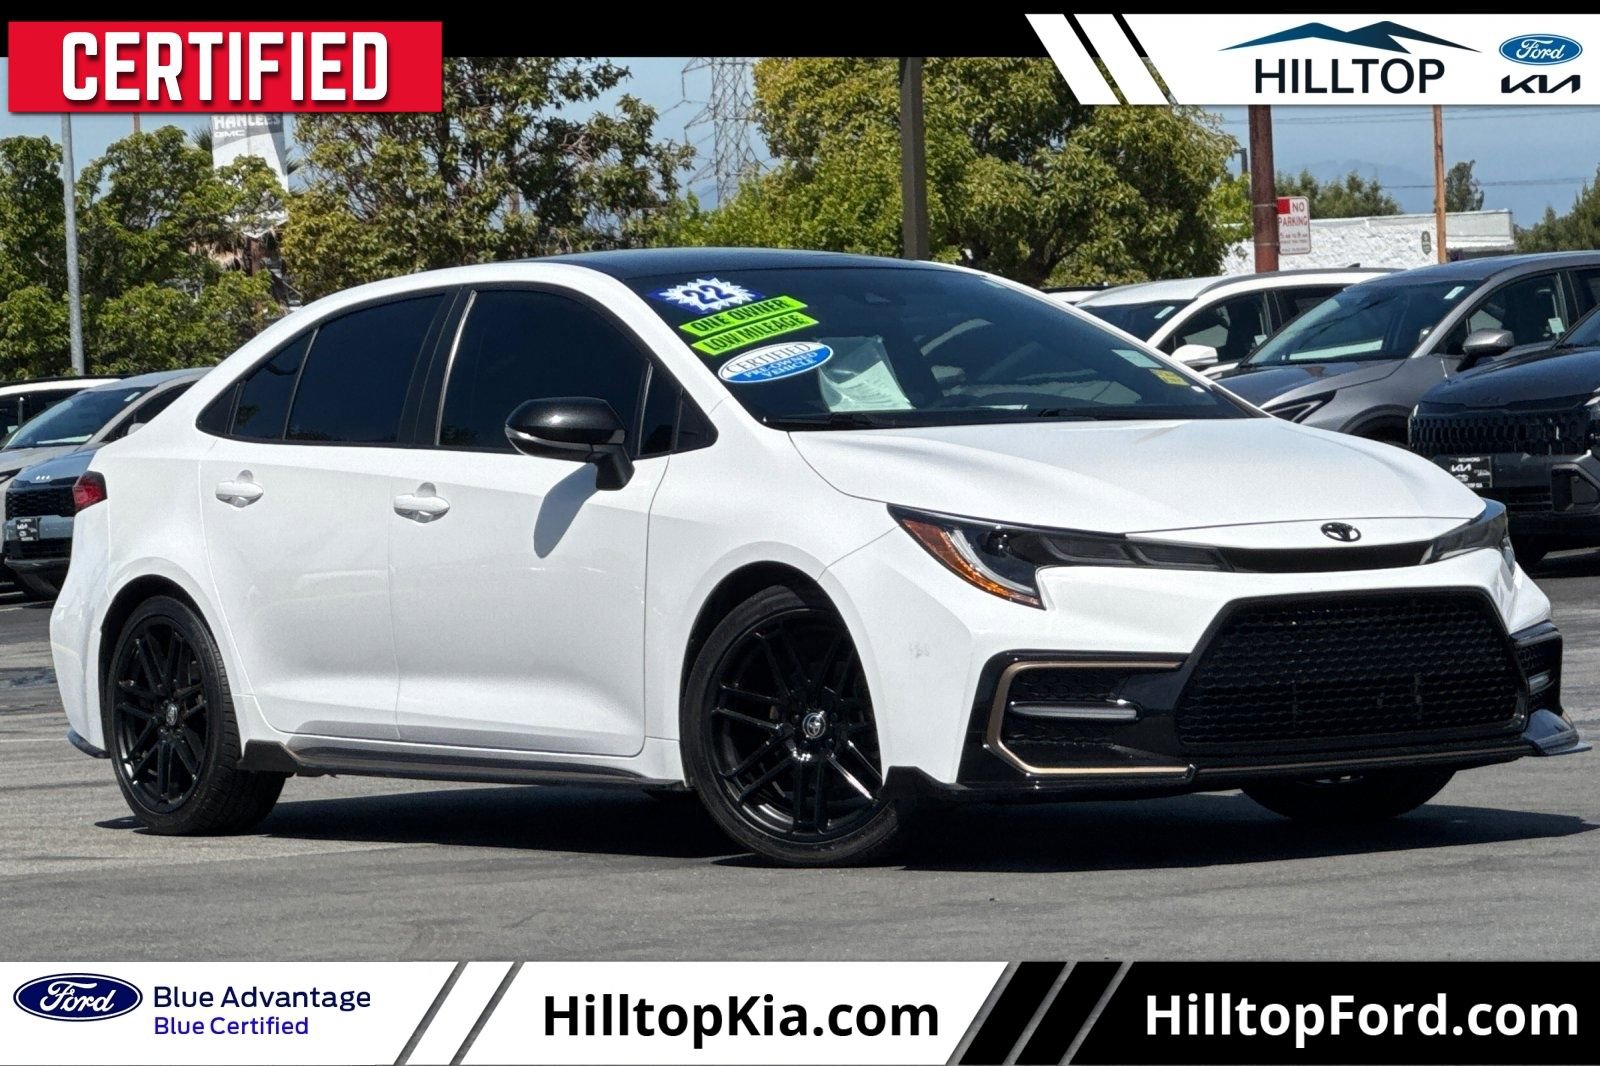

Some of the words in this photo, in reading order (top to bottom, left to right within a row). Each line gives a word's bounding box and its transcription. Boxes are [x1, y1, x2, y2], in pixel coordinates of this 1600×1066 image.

[1292, 201, 1305, 213] NO
[1278, 216, 1308, 227] PARKING
[681, 284, 735, 304] 22
[690, 314, 730, 332] ONE
[727, 298, 788, 321] OWNER
[702, 332, 738, 351] LOW
[736, 314, 805, 340] MILEAGE
[726, 342, 812, 374] CERTIFIED
